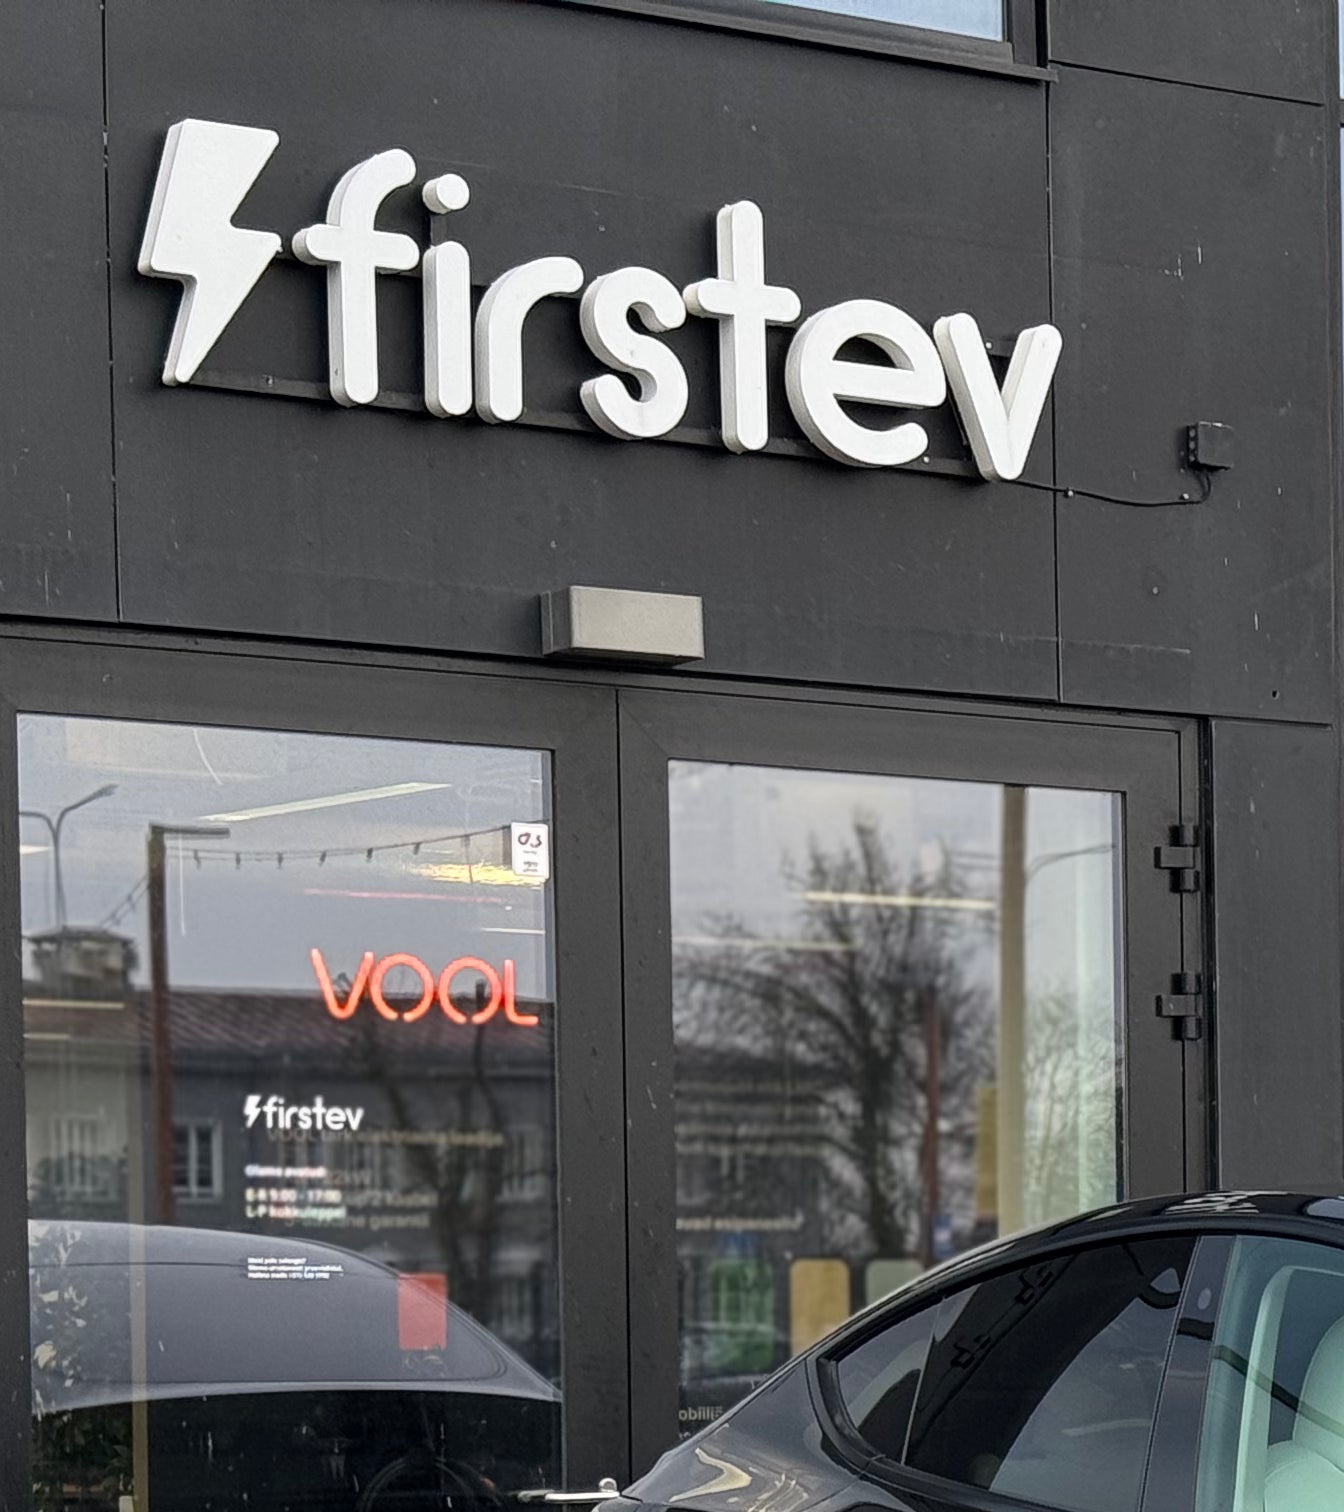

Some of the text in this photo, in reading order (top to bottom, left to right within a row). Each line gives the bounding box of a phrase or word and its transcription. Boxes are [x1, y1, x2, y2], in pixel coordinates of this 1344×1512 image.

[292, 148, 1063, 481] firstev
[310, 948, 539, 1027] VOOL
[262, 1095, 364, 1131] firstev
